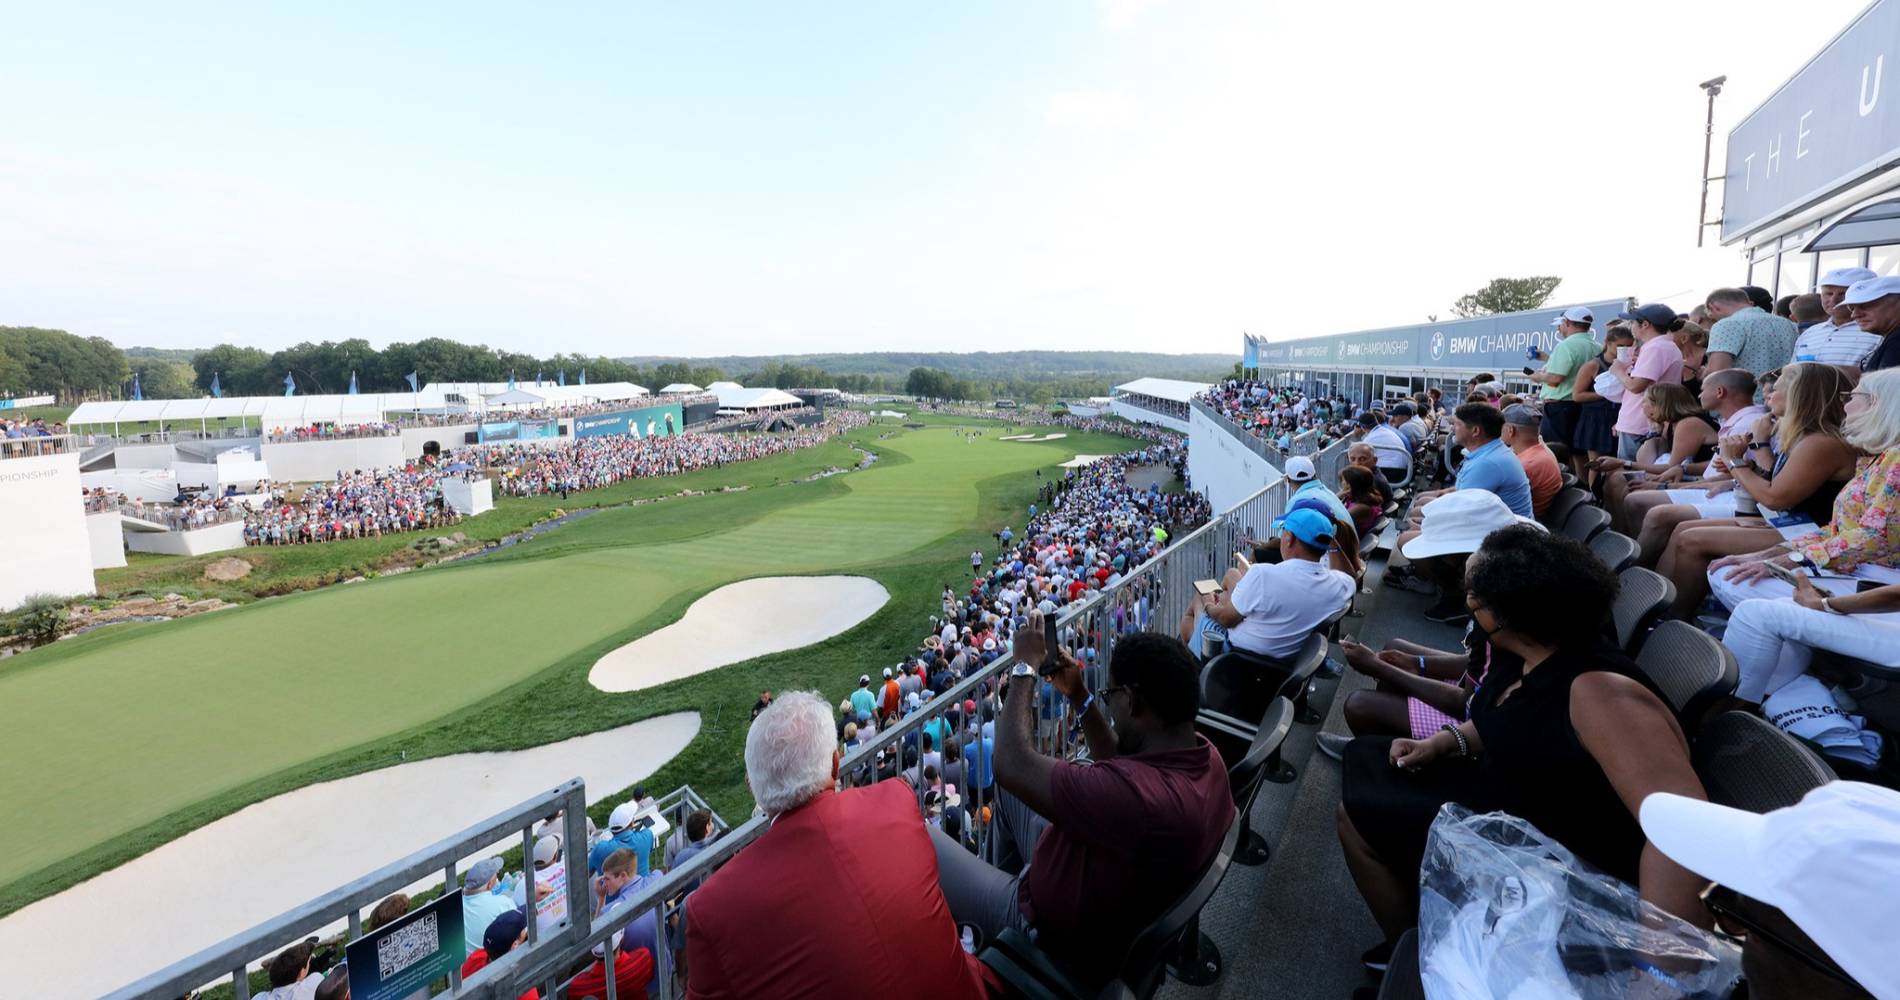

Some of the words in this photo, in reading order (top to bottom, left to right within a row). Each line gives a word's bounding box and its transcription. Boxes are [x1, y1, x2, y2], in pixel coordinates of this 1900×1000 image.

[1745, 110, 1813, 192] THE
[1450, 336, 1477, 354] BMW
[1480, 327, 1597, 353] CHAMPIONS
